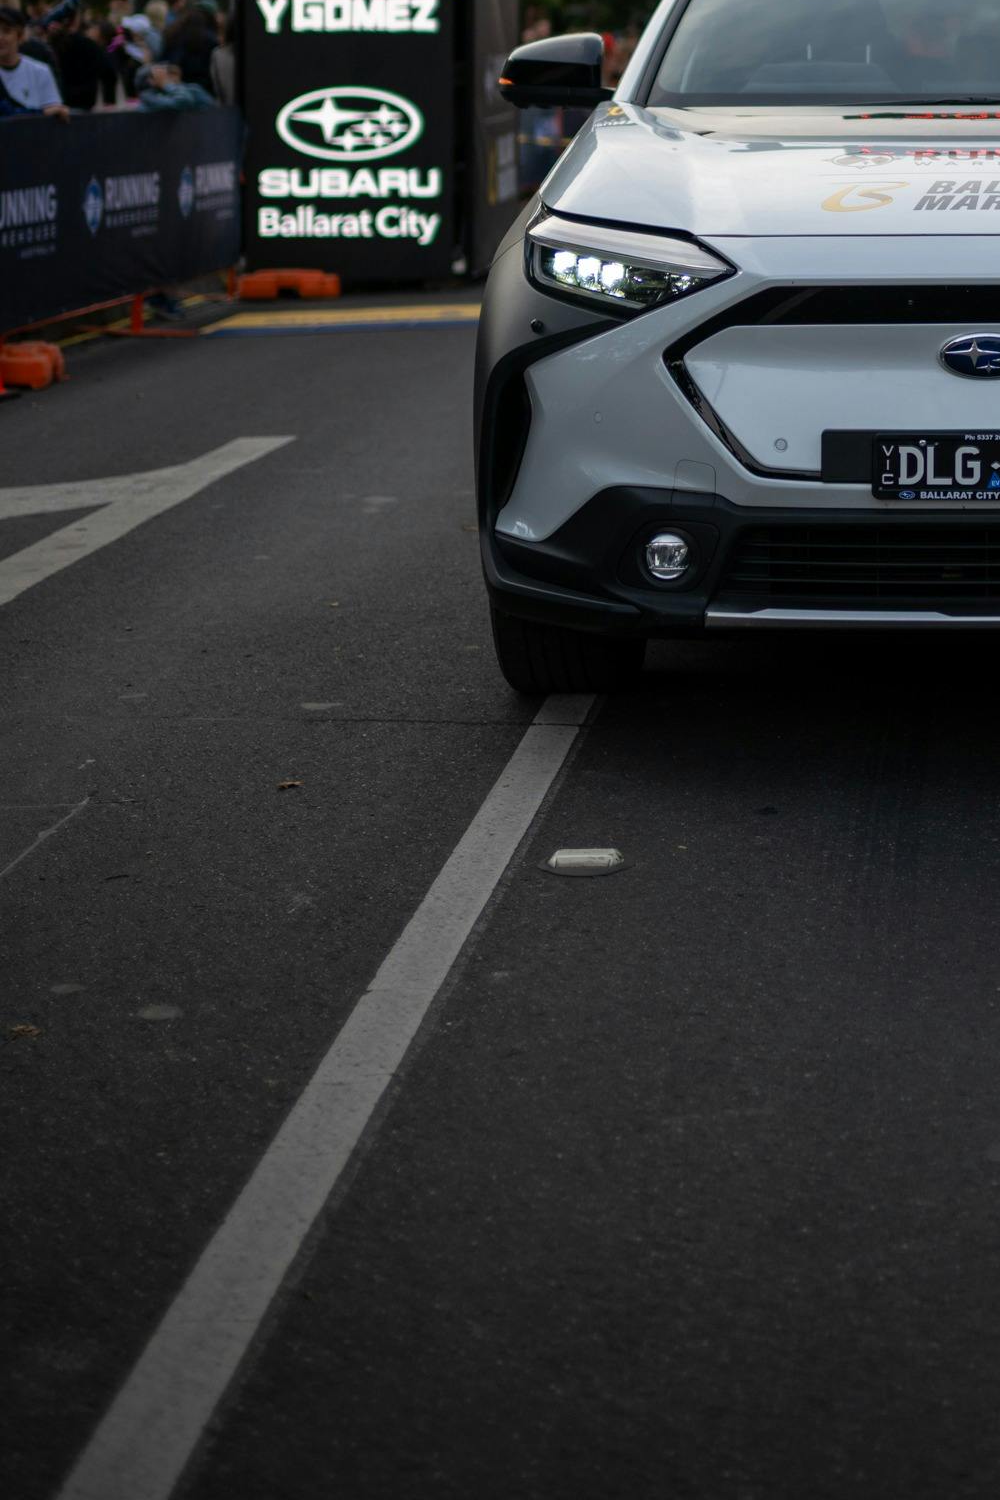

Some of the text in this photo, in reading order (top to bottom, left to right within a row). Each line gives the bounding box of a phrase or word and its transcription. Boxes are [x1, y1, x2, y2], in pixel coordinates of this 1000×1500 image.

[258, 167, 441, 199] SUBARU
[258, 205, 440, 245] Ballarat City
[881, 445, 894, 485] VIC
[898, 446, 981, 486] DLG
[920, 491, 973, 499] BALLARAT
[975, 491, 1000, 500] CITY
